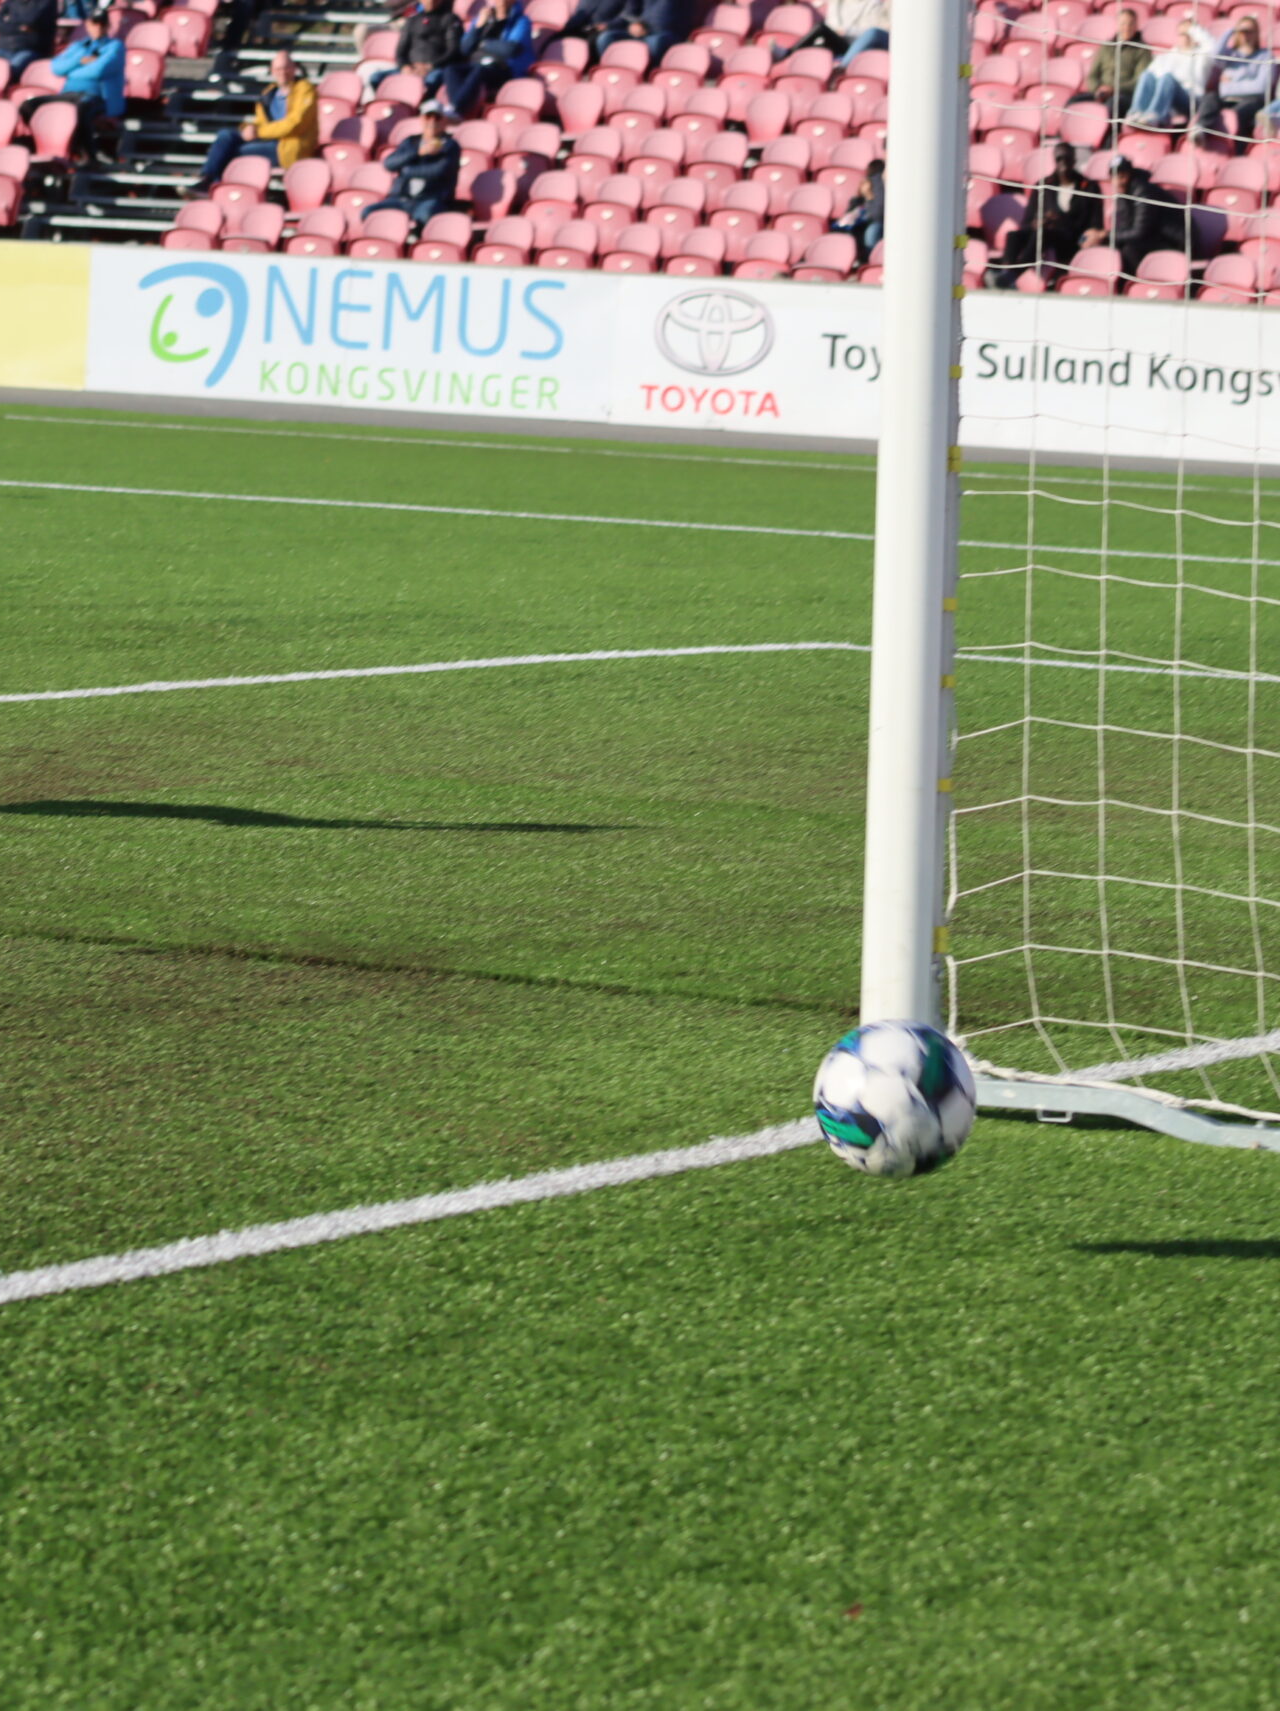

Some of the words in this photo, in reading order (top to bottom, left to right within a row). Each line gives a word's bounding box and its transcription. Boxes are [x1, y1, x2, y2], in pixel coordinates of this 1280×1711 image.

[263, 265, 566, 360] NEMUS
[258, 360, 561, 411] KONGSVINGER
[821, 333, 882, 382] Toy
[977, 343, 1131, 387] Sulland
[1148, 352, 1279, 405] Kongs
[639, 384, 781, 418] TOYOTA
